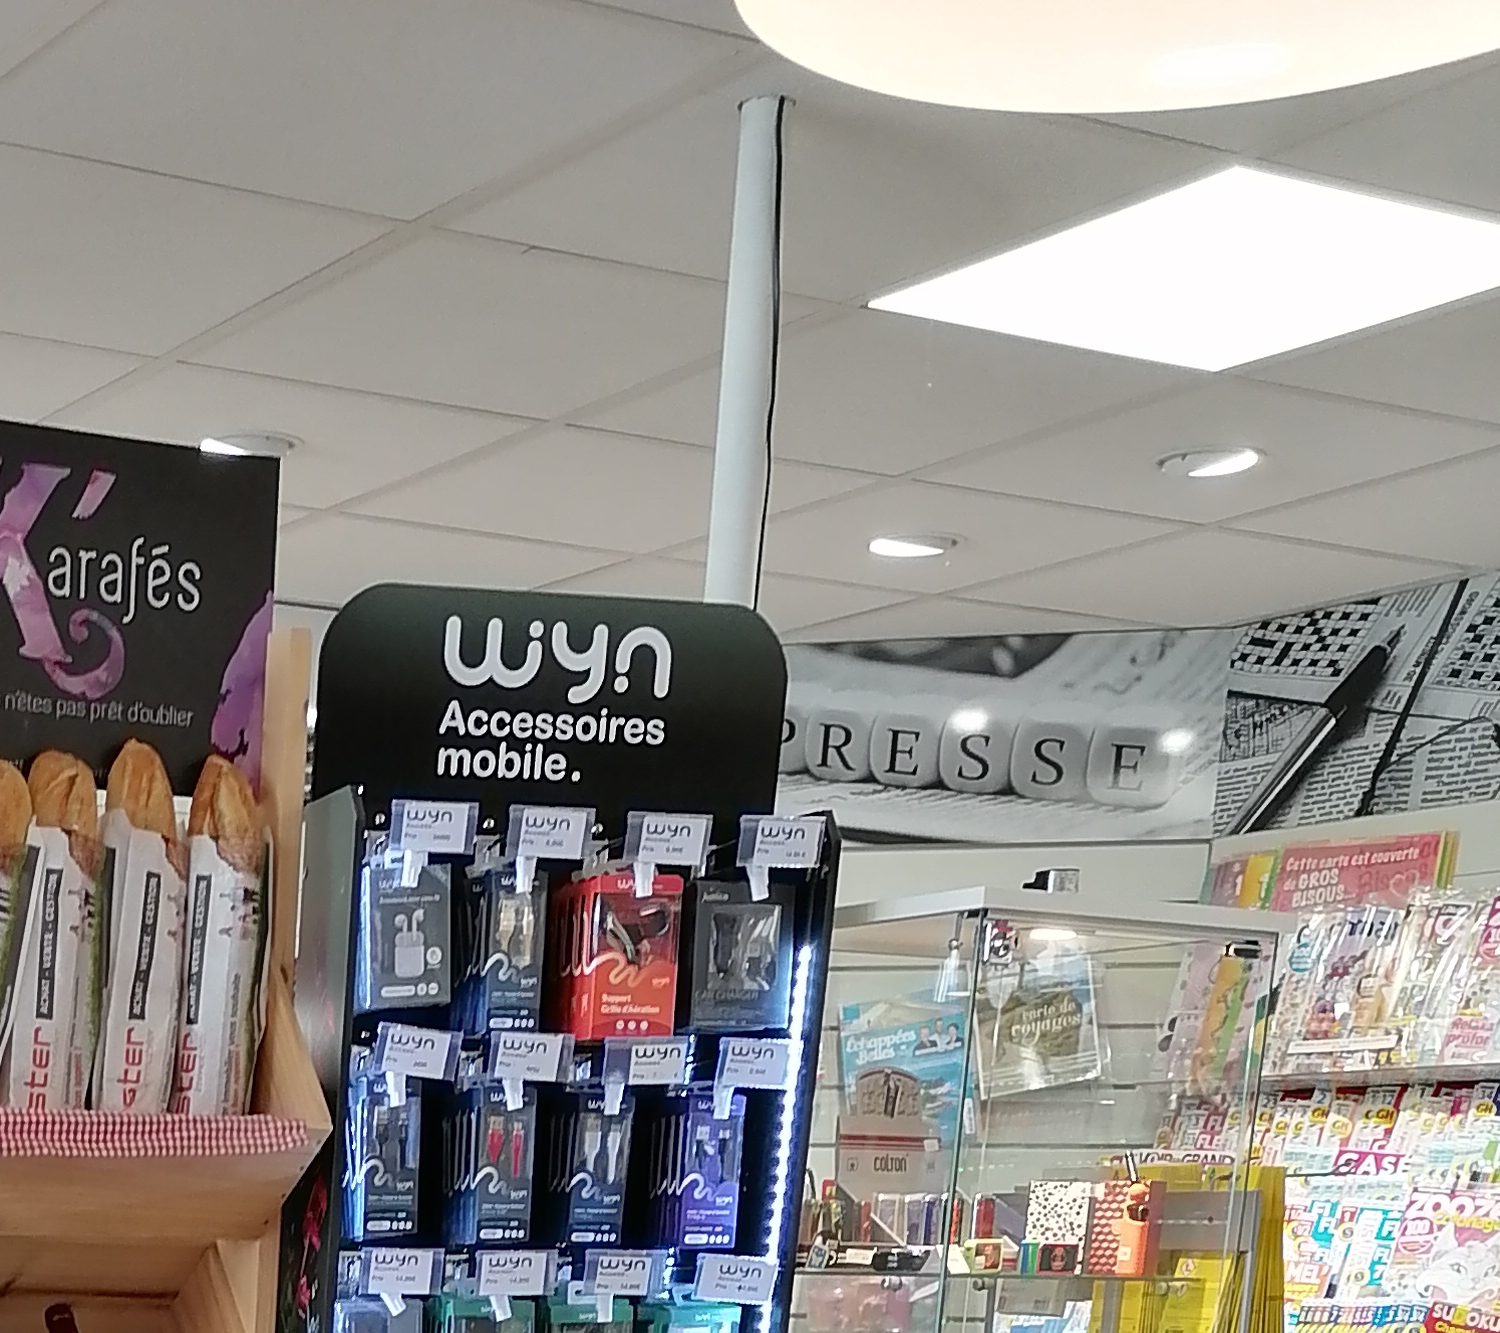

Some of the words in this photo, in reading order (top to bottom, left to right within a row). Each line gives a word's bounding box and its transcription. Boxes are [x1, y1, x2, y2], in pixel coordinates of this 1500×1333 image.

[443, 614, 673, 704] wyn
[4, 690, 52, 713] n'êtes
[56, 699, 86, 721] pas
[90, 700, 124, 724] prêt
[127, 702, 194, 728] d'oublier
[438, 699, 666, 746] Accessoires
[436, 742, 583, 784] mobile.
[407, 809, 452, 826] wyn
[525, 817, 571, 832] wyn
[646, 823, 691, 838] wyn
[761, 825, 805, 841] wyn
[1286, 856, 1317, 871] Cette
[1318, 854, 1350, 869] carte
[1351, 851, 1370, 866] est
[1370, 847, 1420, 865] couverte
[1299, 868, 1339, 890] GROS
[390, 1035, 435, 1052] wyn
[503, 1038, 547, 1055] wyn
[635, 1044, 681, 1061] wyn
[731, 1044, 775, 1061] wyn
[856, 1049, 896, 1066] Belles
[375, 1253, 418, 1269] wyn
[488, 1255, 532, 1271] wyn
[600, 1257, 645, 1273] wyn
[719, 1263, 761, 1279] wyn
